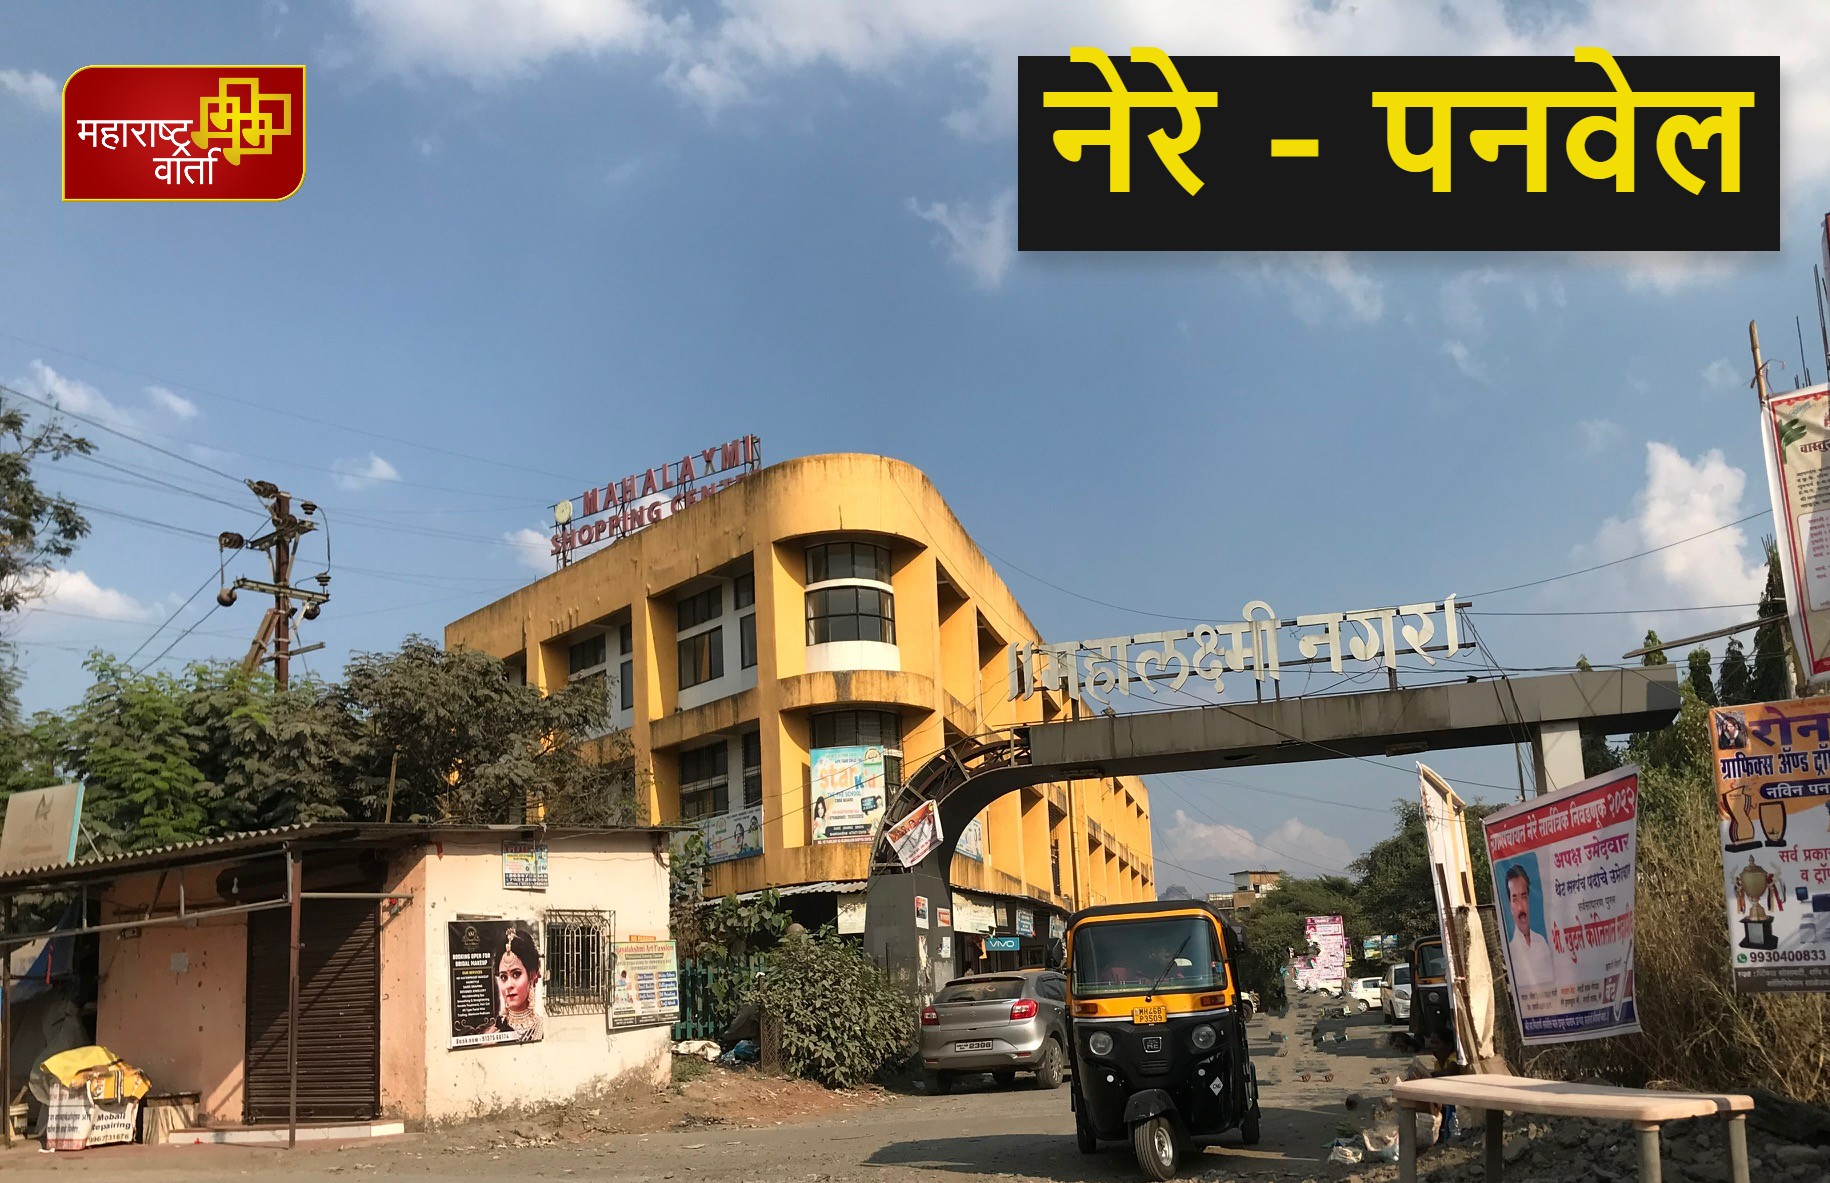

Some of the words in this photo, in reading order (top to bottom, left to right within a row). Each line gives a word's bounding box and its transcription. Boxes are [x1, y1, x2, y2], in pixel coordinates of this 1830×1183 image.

[1800, 439, 1830, 453] वास्तु
[583, 434, 754, 516] MAHALAXMI
[551, 501, 663, 555] SHOPPING
[1720, 751, 1774, 780] ग्राफिक्स
[1812, 743, 1830, 776] ट्रॉ
[1766, 783, 1803, 799] नविन
[1554, 843, 1582, 869] अपक्ष
[1583, 833, 1630, 861] उमेदवार
[1779, 844, 1798, 863] सर्व
[1802, 848, 1830, 861] प्रका
[1800, 869, 1809, 882] व
[1749, 949, 1827, 963] 9930400833
[1140, 1015, 1162, 1023] P3509
